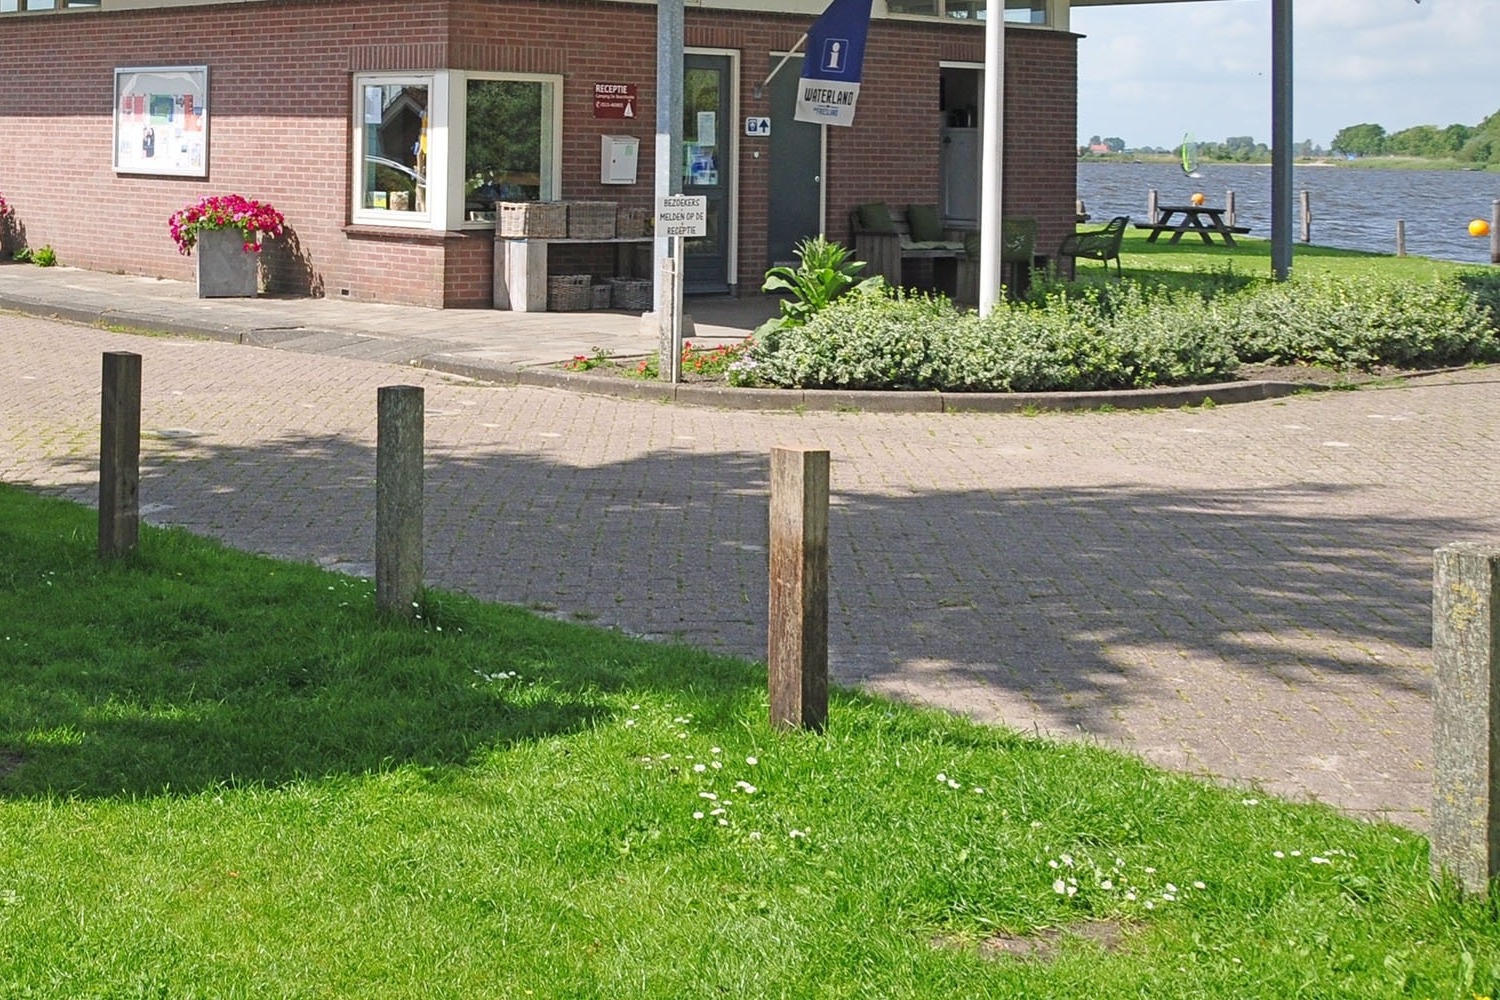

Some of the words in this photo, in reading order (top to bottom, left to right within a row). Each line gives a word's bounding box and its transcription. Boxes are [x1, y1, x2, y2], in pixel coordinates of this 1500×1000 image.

[595, 84, 628, 94] RECEPTIE
[804, 87, 854, 106] WATERLAND
[663, 198, 701, 207] BEZOEKERS
[659, 212, 685, 221] MELDEN
[686, 211, 695, 220] OP
[695, 211, 705, 220] DE
[667, 226, 697, 235] RECEPTIE
